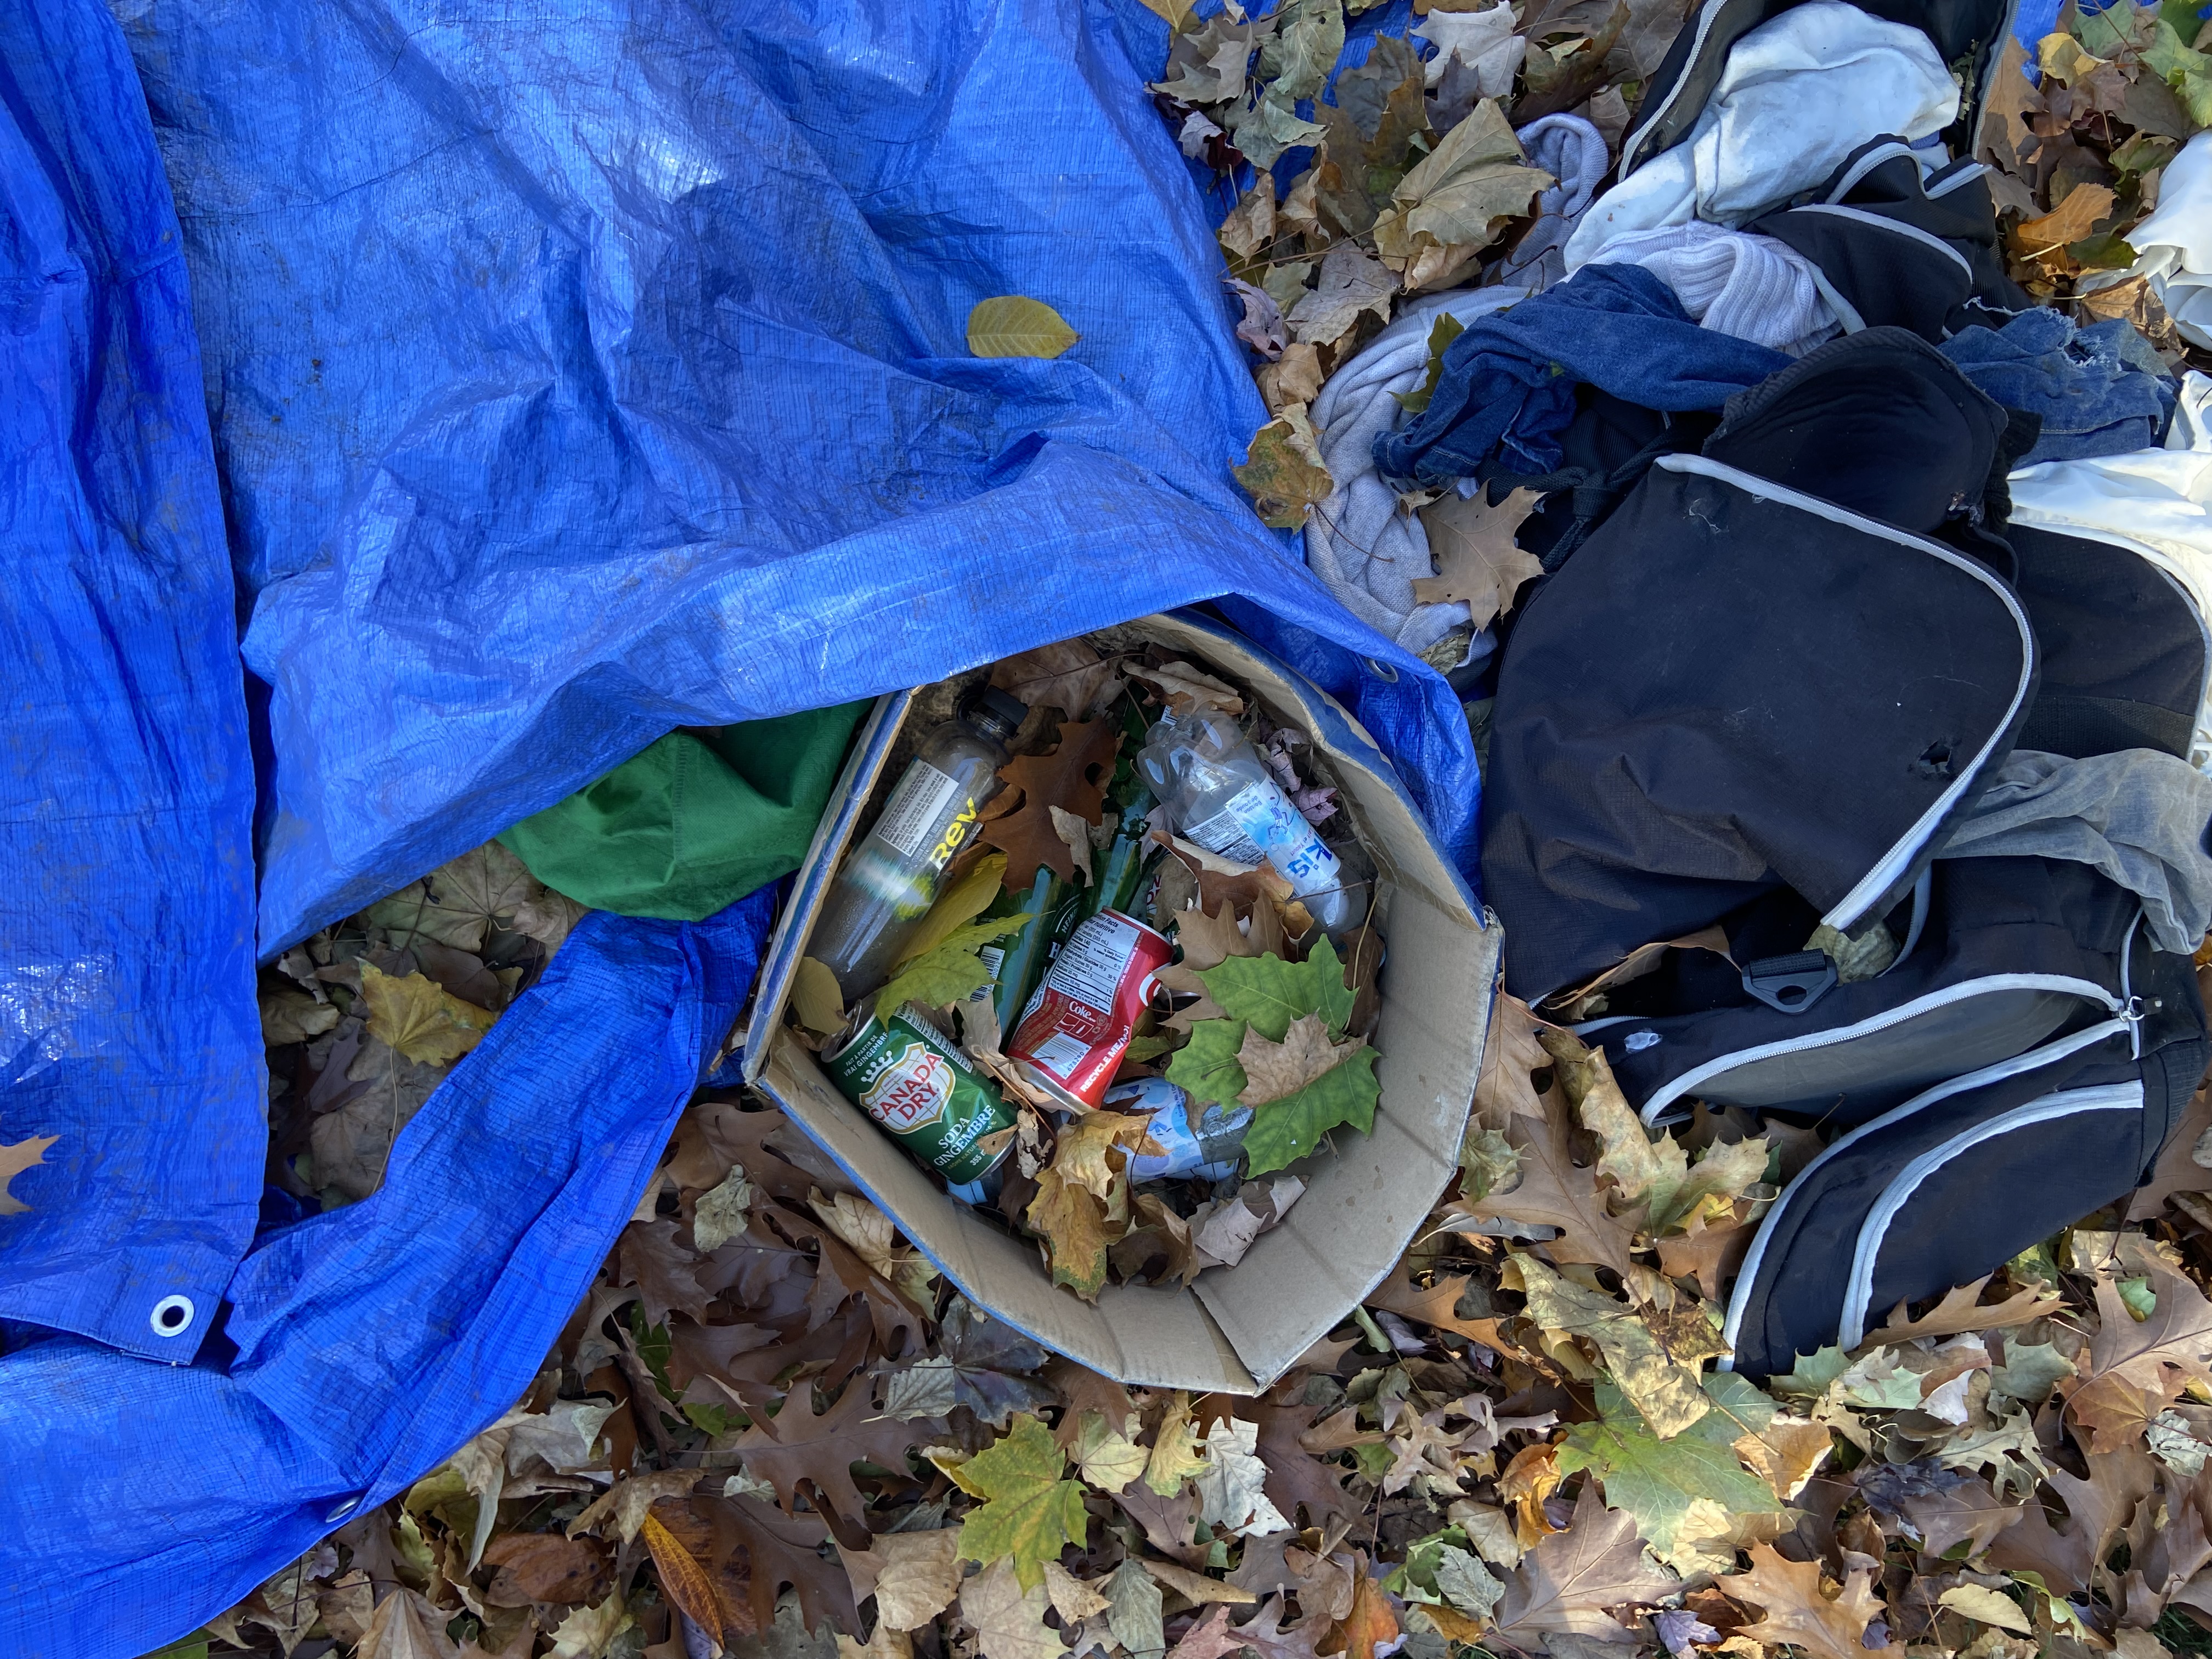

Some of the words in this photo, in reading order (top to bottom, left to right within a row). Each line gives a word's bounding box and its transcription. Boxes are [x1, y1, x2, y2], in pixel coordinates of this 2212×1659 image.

[1243, 800, 1262, 814] Boisson
[1250, 795, 1259, 804] de
[929, 797, 977, 870] Rev
[1288, 838, 1333, 878] kis
[1289, 842, 1305, 856] Yaourt
[1093, 920, 1115, 934] nutritive
[1104, 917, 1119, 928] Facts
[1069, 1001, 1092, 1019] Coke
[845, 1057, 855, 1066] FAIT
[857, 1040, 872, 1057] PARTIR
[870, 1034, 878, 1042] DE
[843, 1064, 858, 1076] VRAI
[1080, 1055, 1111, 1093] RECYCLE
[868, 1053, 944, 1122] CANADA
[898, 1082, 939, 1121] DRY
[934, 1105, 996, 1166] GINGEMBRE
[938, 1117, 970, 1149] SODA
[983, 1125, 992, 1135] 100
[969, 1153, 982, 1166] 355
